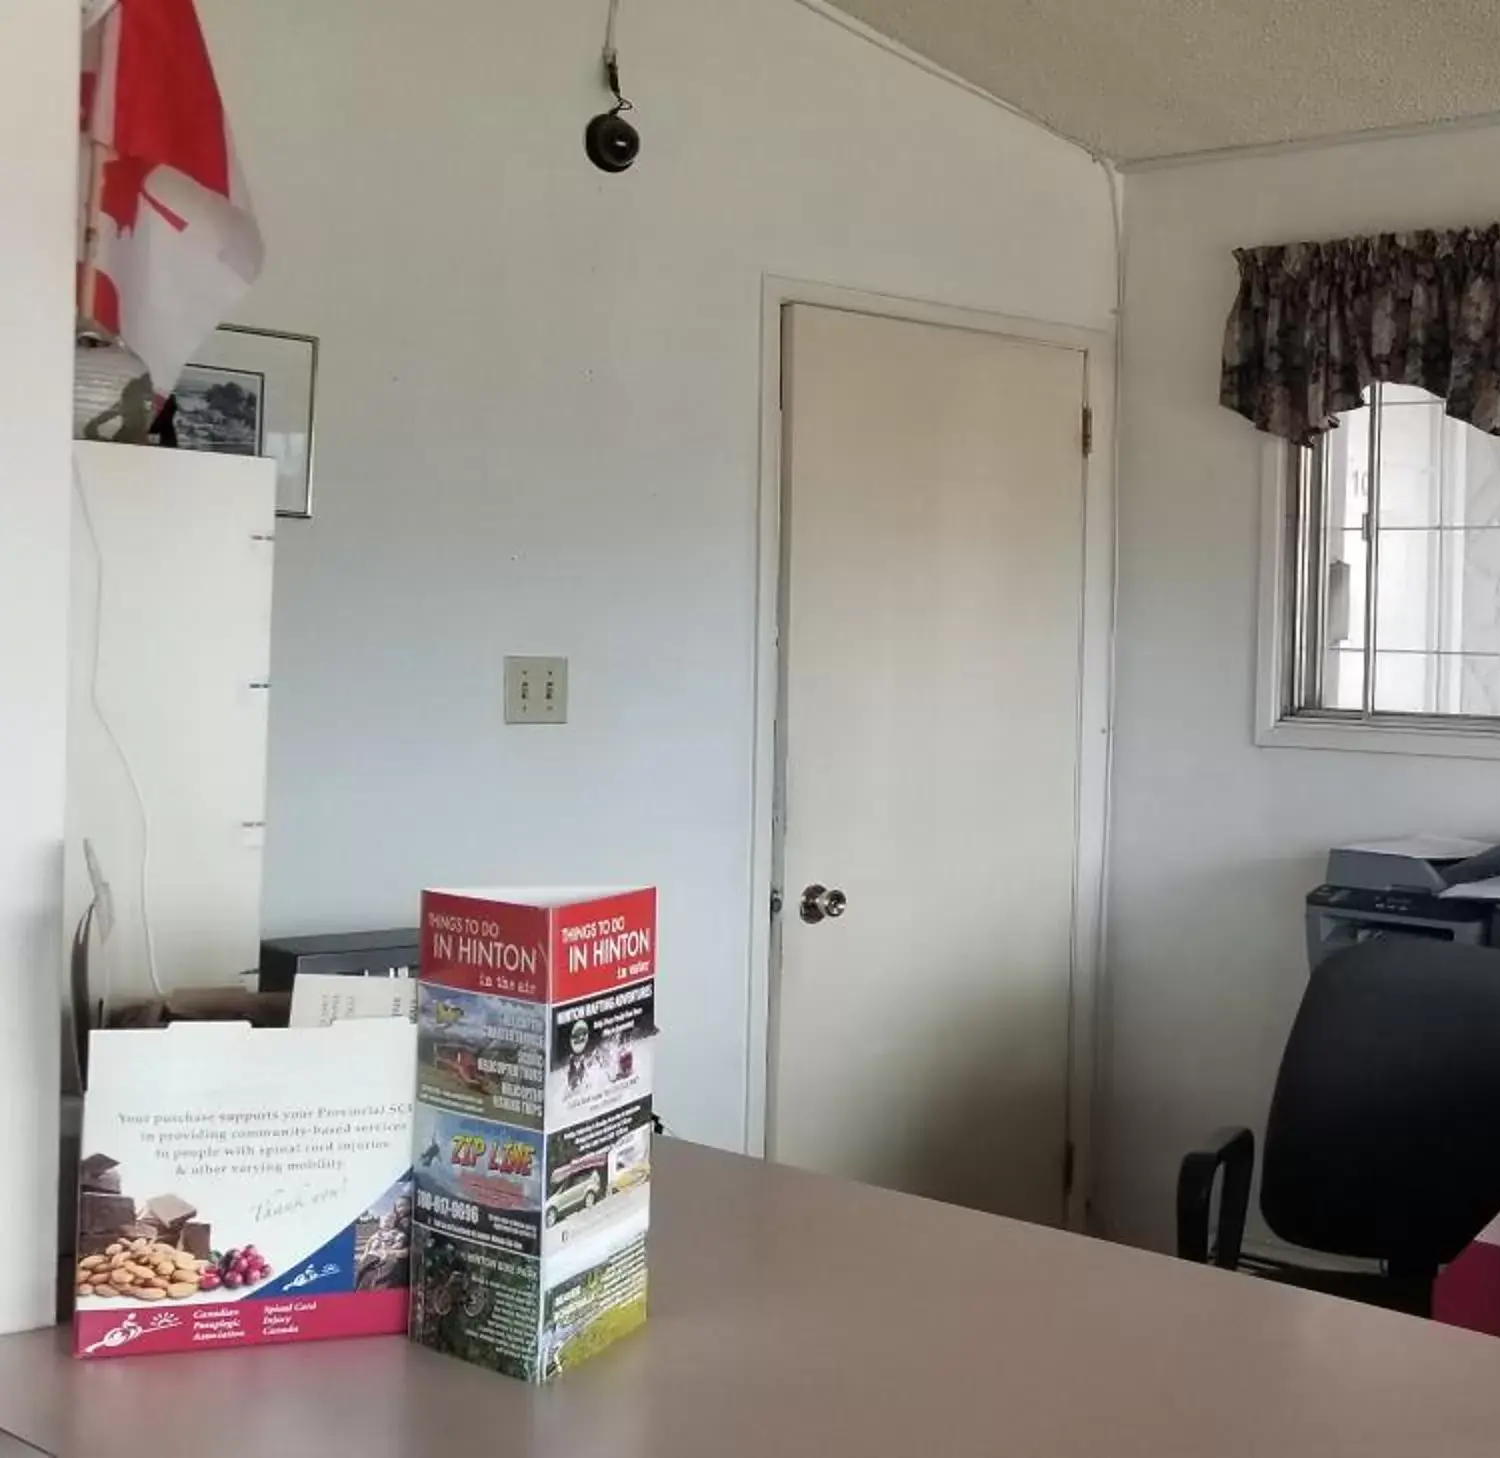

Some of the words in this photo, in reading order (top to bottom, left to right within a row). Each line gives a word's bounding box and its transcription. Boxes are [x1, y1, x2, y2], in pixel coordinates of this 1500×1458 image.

[428, 911, 463, 934] THINGS
[465, 918, 479, 935] TO
[481, 920, 500, 939] DO
[562, 922, 598, 944] THINGS
[598, 918, 611, 935] TO
[611, 915, 625, 934] DO
[433, 932, 453, 961] IN
[459, 935, 538, 976] HINTON
[569, 941, 588, 974] IN
[592, 927, 651, 968] HINTON
[496, 975, 515, 991] the
[518, 980, 537, 995] air
[118, 1111, 148, 1125] Your
[153, 1109, 214, 1126] purchase
[219, 1109, 279, 1125] supports
[282, 1108, 313, 1123] your
[317, 1103, 384, 1120] Provincial
[140, 1131, 155, 1142] in
[160, 1128, 227, 1144] providing
[232, 1123, 351, 1139] community-based
[355, 1121, 407, 1133] services
[173, 1147, 220, 1162] people
[224, 1145, 254, 1158] with
[260, 1143, 300, 1158] spinal
[305, 1140, 334, 1153] cord
[338, 1139, 389, 1154] injuries
[450, 1134, 486, 1167] ZIP
[487, 1139, 537, 1177] LINE
[175, 1163, 186, 1176] &
[192, 1162, 227, 1176] other
[231, 1160, 283, 1175] varying
[287, 1158, 344, 1173] mobility
